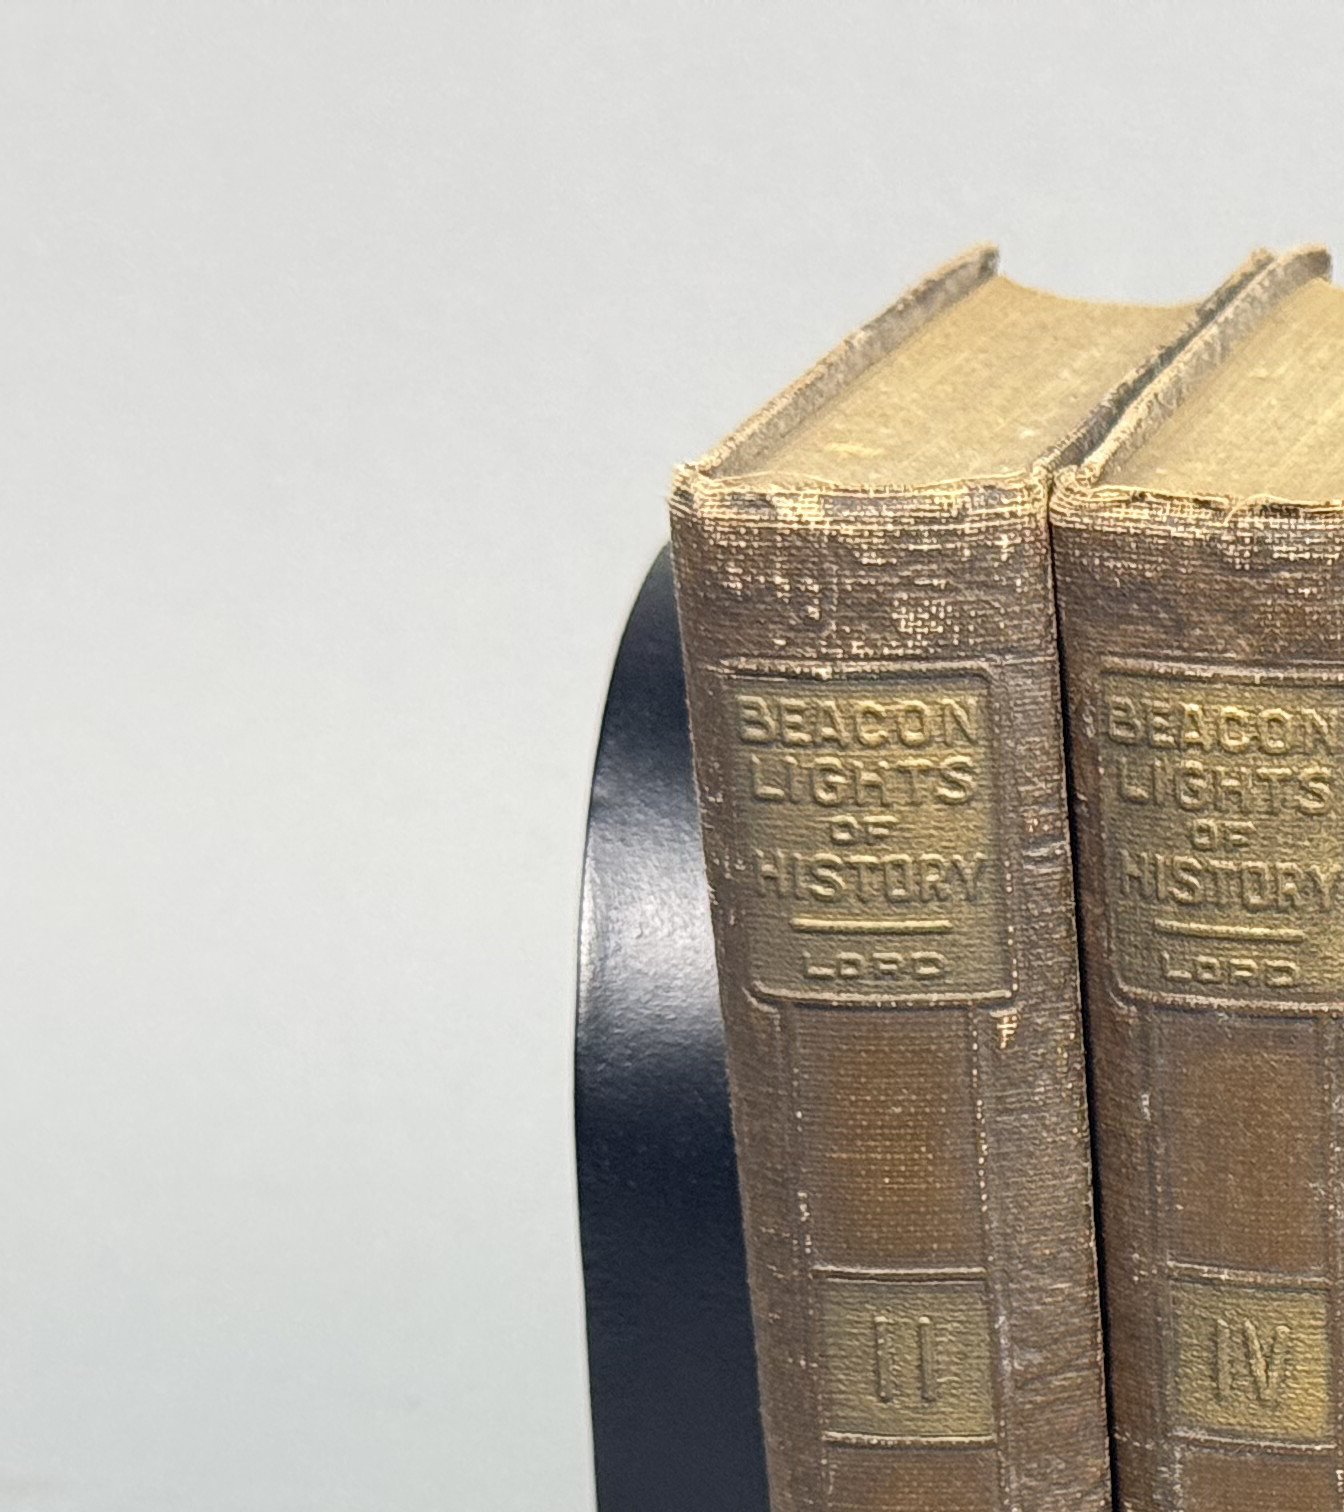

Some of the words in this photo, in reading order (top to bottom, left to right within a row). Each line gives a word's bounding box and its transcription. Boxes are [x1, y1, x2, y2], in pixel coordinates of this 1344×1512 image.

[737, 695, 980, 748] BEACON
[1106, 701, 1339, 756] BEACON
[749, 755, 977, 805] LIGHTS
[1116, 759, 1335, 815] LIGHTS
[829, 814, 891, 846] OF
[1191, 819, 1254, 851] OF
[755, 850, 987, 902] HISTORY
[1121, 852, 1344, 910] HISTORY
[802, 950, 946, 980] LORD
[1162, 951, 1299, 987] LORD
[874, 1315, 935, 1402] II
[1216, 1317, 1291, 1409] IV
